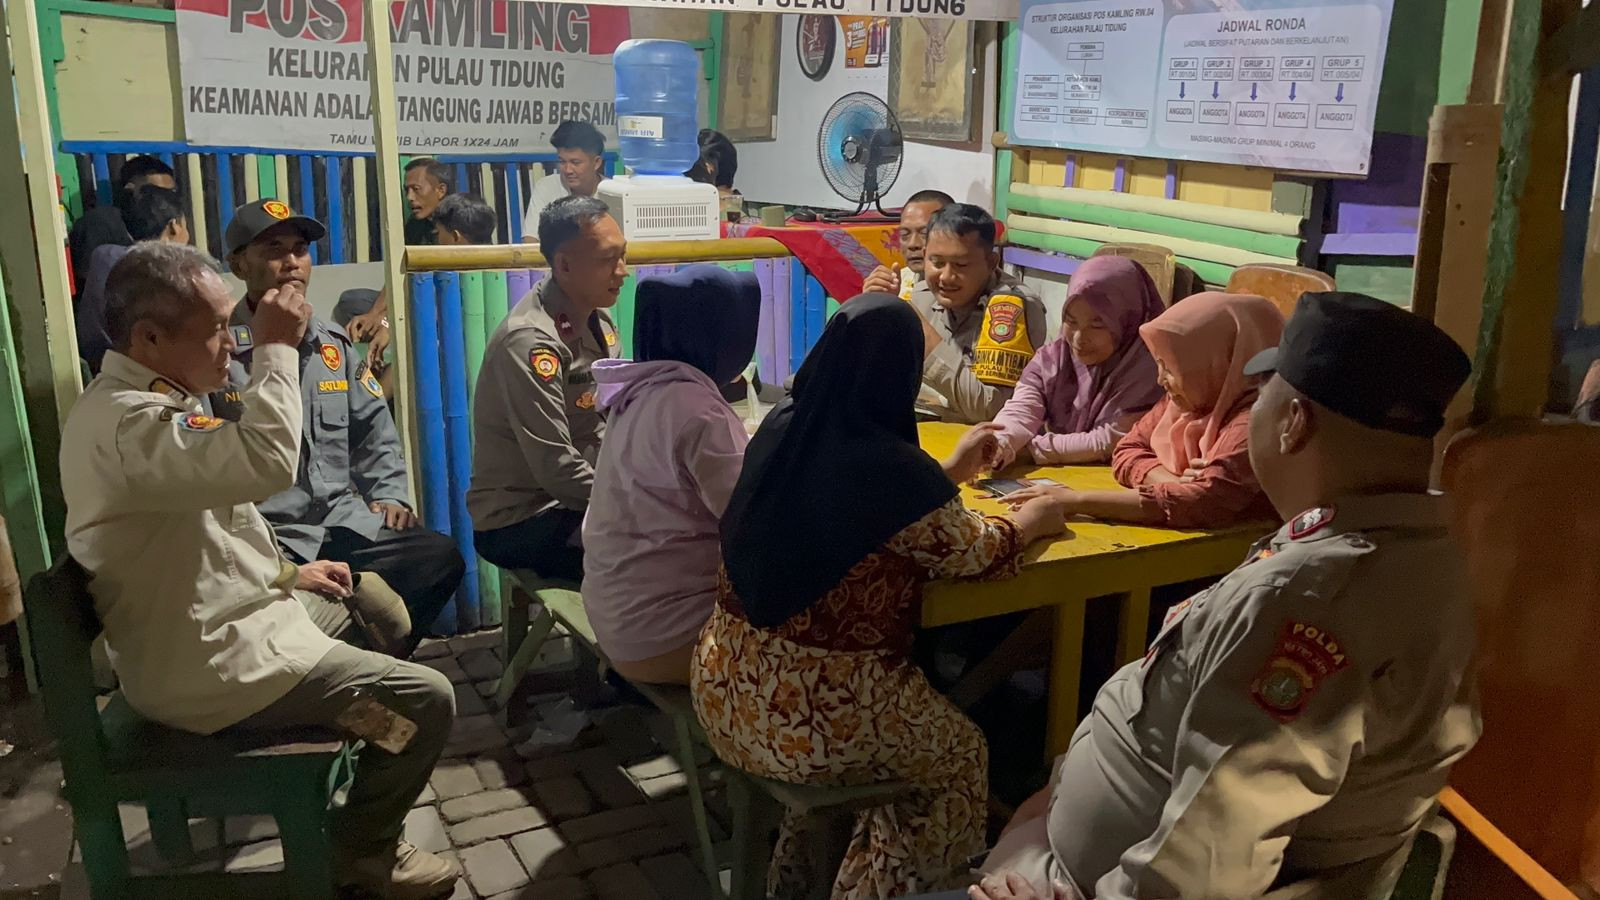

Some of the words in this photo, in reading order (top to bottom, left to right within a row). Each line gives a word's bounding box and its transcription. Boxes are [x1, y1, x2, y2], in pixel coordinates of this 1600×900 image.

[1058, 11, 1092, 22] ORGANISASI
[1093, 11, 1105, 19] POS
[1107, 9, 1133, 19] KAMLING
[1050, 24, 1085, 34] KELURAHAN
[1085, 23, 1103, 33] PULAU
[1104, 23, 1127, 32] TIDUNG
[1217, 20, 1261, 33] JADWAL
[1265, 17, 1306, 31] RONDA
[268, 47, 410, 82] KELURAN
[417, 56, 484, 86] PULAU
[490, 59, 565, 88] TIDUNG
[1173, 60, 1189, 68] GRUP
[1284, 59, 1304, 67] GRUP
[1327, 59, 1351, 67] GRUP
[190, 86, 307, 117] KEAMANAN
[313, 92, 375, 120] ADALA
[398, 96, 481, 124] TANGUNG
[486, 99, 543, 125] JAWAB
[549, 101, 617, 126] BERSAM
[1169, 107, 1192, 115] ANGGOTA
[1277, 111, 1306, 119] ANGGOTA
[1320, 113, 1353, 121] ANGGOTA
[330, 133, 367, 145] TAMU
[416, 136, 458, 147] LAPOR
[463, 137, 490, 147] 1X24
[493, 137, 519, 147] JAM
[1289, 140, 1316, 149] ORANG
[1293, 623, 1345, 666] POLDA
